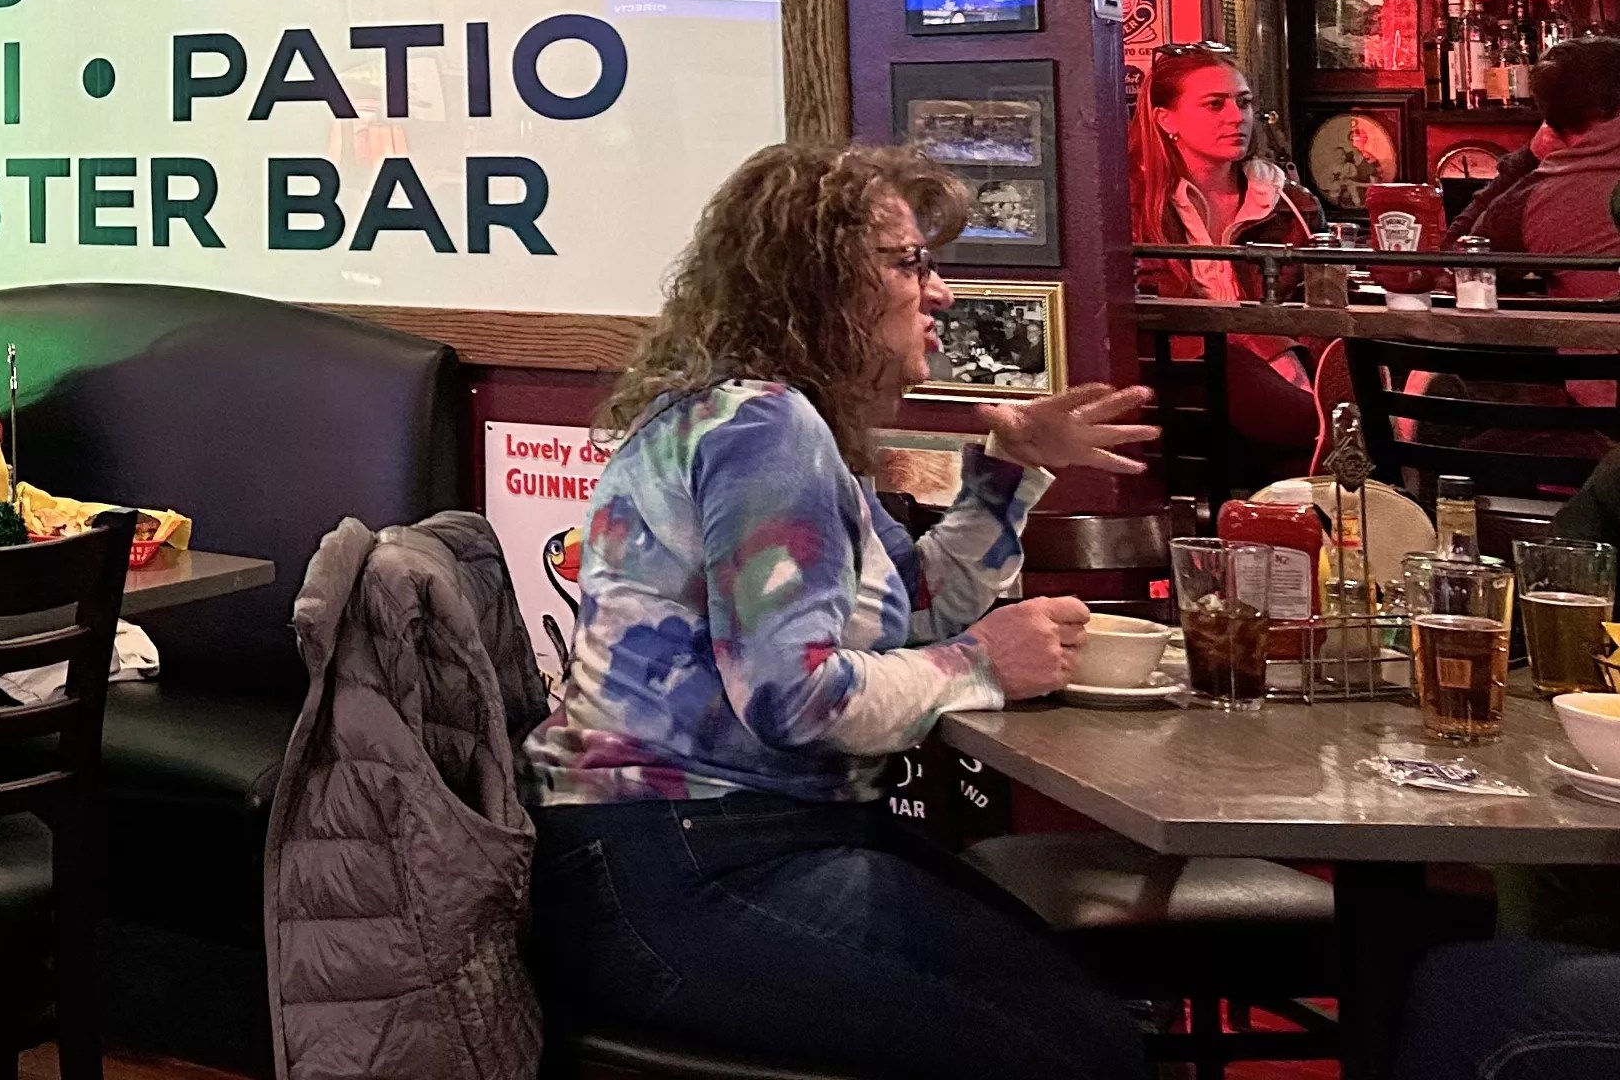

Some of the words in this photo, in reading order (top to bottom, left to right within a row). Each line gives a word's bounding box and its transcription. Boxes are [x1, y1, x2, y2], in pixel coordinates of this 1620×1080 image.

[171, 12, 629, 122] PATIO
[267, 154, 558, 256] BAR
[506, 433, 572, 466] Lovely
